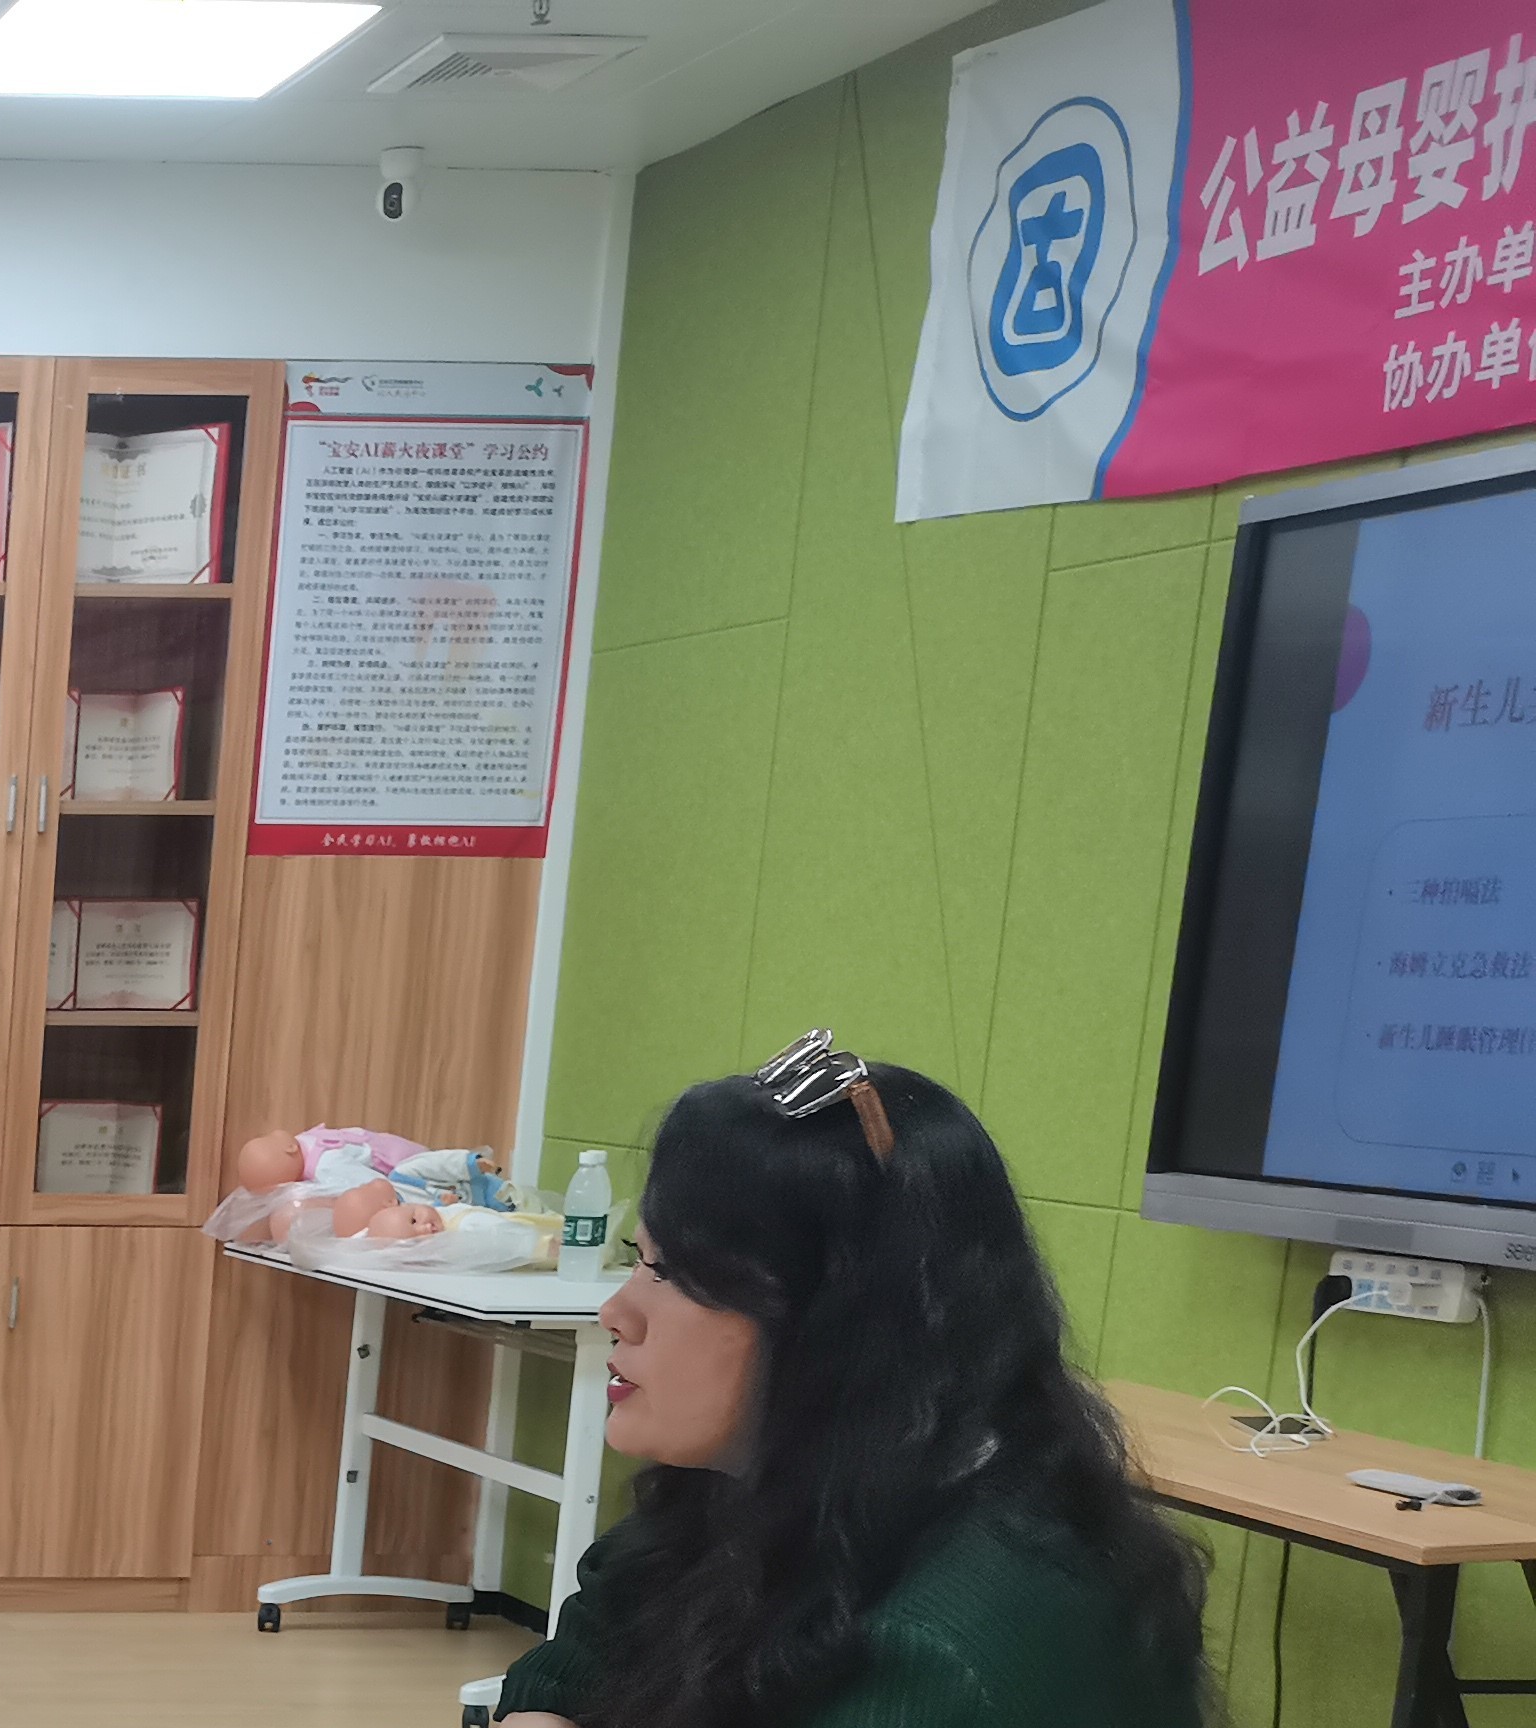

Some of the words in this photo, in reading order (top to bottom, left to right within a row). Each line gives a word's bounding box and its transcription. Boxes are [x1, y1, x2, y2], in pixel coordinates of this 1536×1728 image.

[1382, 317, 1536, 412] 协办单
[1424, 676, 1536, 732] 新生儿
[1389, 951, 1536, 979] 海姆立克急救法
